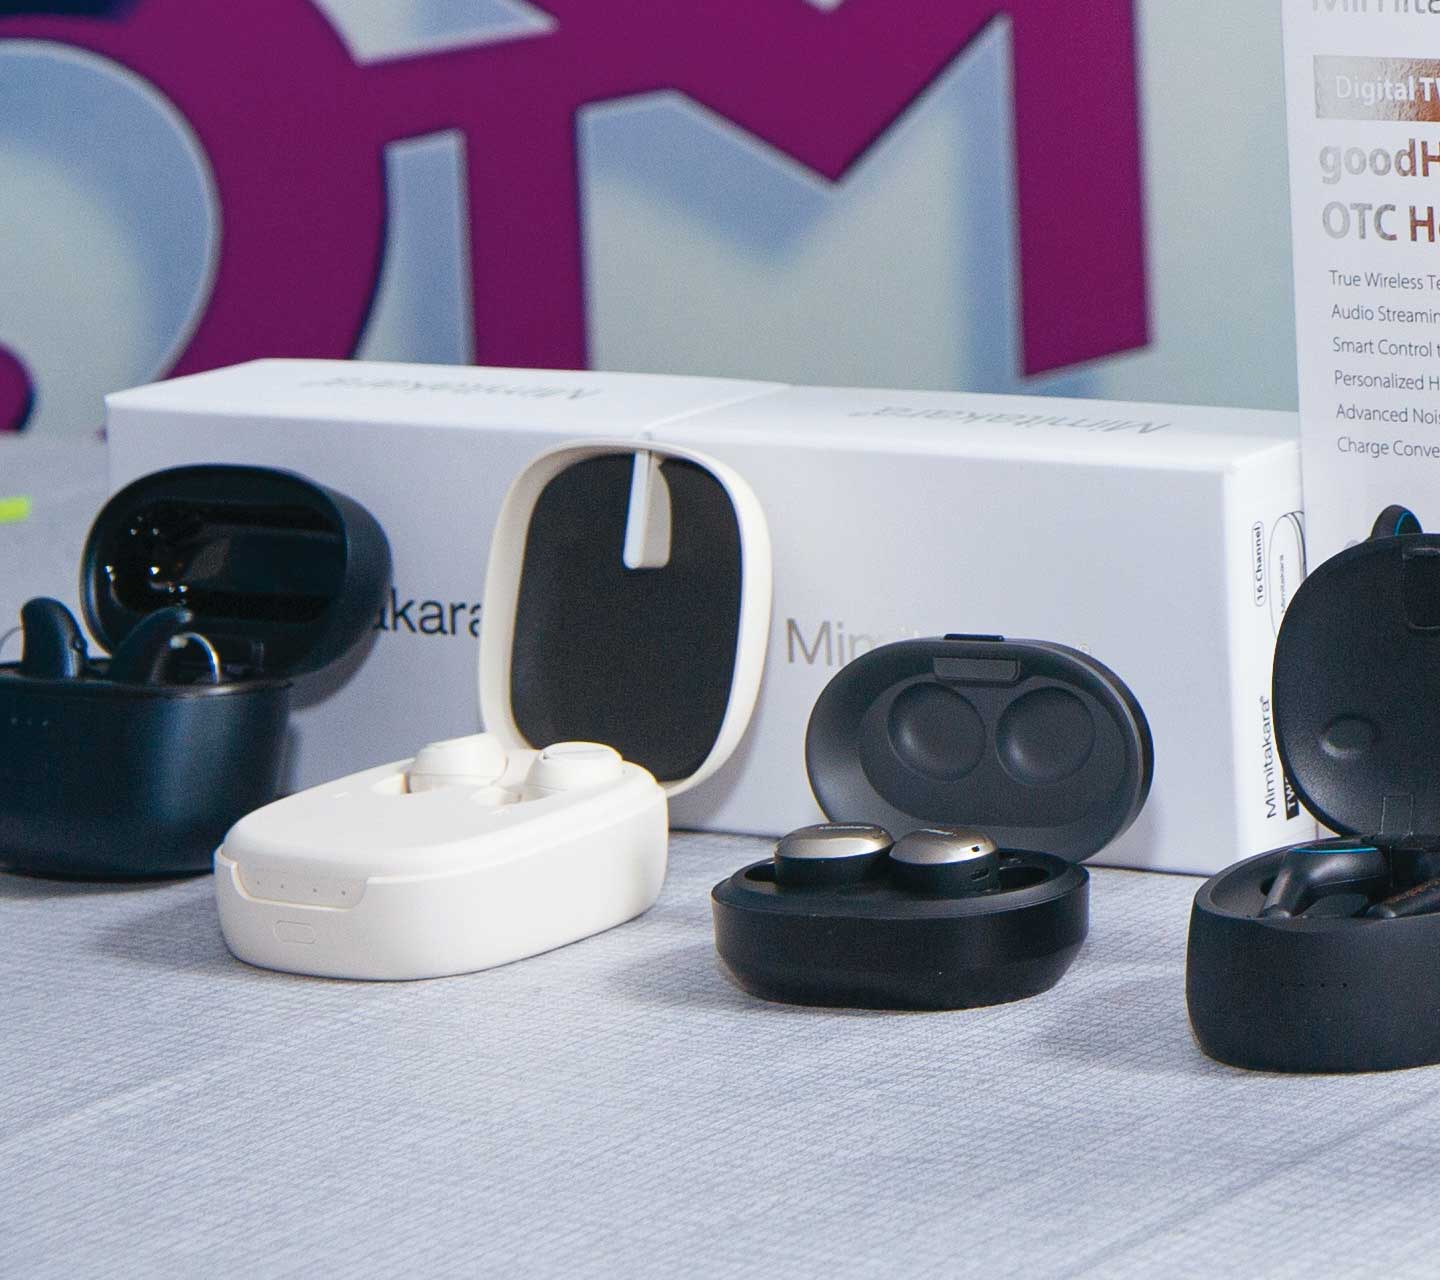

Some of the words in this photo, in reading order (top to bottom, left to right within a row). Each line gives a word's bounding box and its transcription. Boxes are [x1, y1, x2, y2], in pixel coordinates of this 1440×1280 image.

[1336, 74, 1416, 106] Digital
[1322, 201, 1397, 240] OTC
[1330, 270, 1361, 288] True
[1365, 272, 1424, 290] Wireless
[1331, 304, 1374, 322] Audio
[1333, 338, 1374, 355] Smart
[1378, 340, 1432, 358] Control
[1334, 371, 1424, 391] Personalized
[1336, 404, 1409, 424] Advanced
[1338, 437, 1389, 459] Charge
[1254, 526, 1263, 582] Channel
